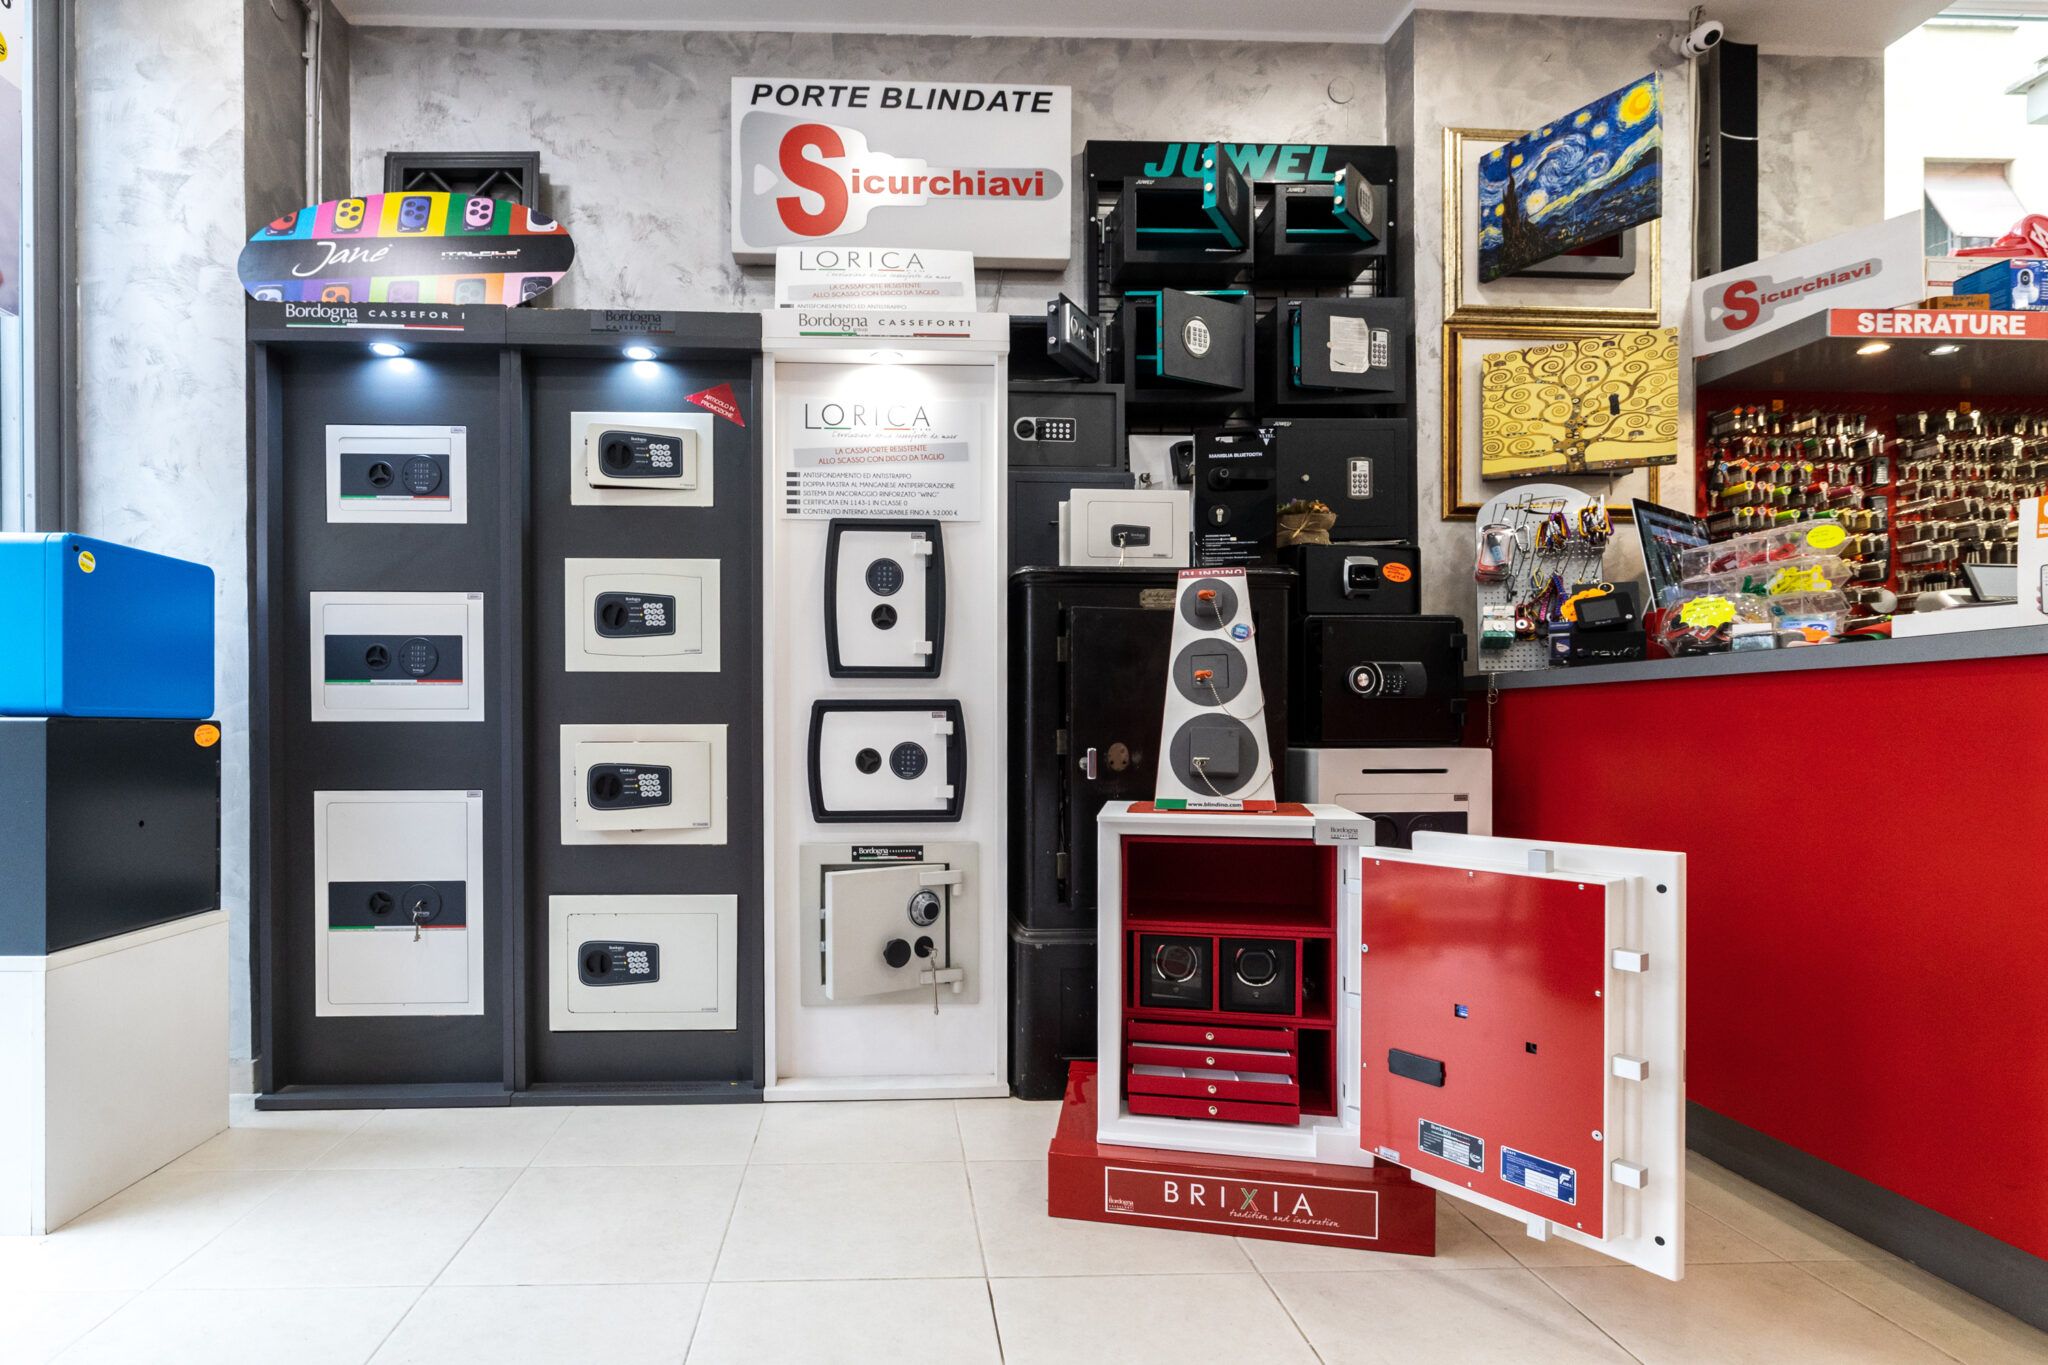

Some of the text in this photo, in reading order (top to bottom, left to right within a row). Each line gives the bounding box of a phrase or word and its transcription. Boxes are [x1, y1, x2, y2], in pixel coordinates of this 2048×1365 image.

[750, 83, 1054, 113] PORTE BLINDATE
[1144, 143, 1335, 181] JUWEL
[776, 123, 1044, 237] Sicurchiavi
[800, 250, 924, 271] LORICA
[841, 282, 883, 290] CASSAFORTE
[884, 281, 921, 289] RESISTENTE
[1722, 262, 1871, 331] Sicurchiavi
[285, 303, 358, 323] Bordogna
[605, 311, 662, 325] Bordogna
[799, 313, 971, 332] Bordogna CASSEFORTI
[1857, 312, 2026, 335] SERRATURE
[700, 399, 734, 418] PROMOZIONE
[704, 394, 728, 409] ARTICOLO
[805, 403, 930, 429] LORICA
[843, 446, 888, 454] CASSAFORTE
[889, 444, 928, 452] RESISTENTE
[818, 457, 836, 465] ALLO
[837, 456, 865, 464] SCASSO
[920, 453, 945, 461] TAGLIO
[870, 508, 909, 516] ASSICURABILE
[858, 847, 889, 856] Bordogna
[1164, 1180, 1313, 1217] BRIXIA
[1229, 1209, 1340, 1228] tradition and innovation
